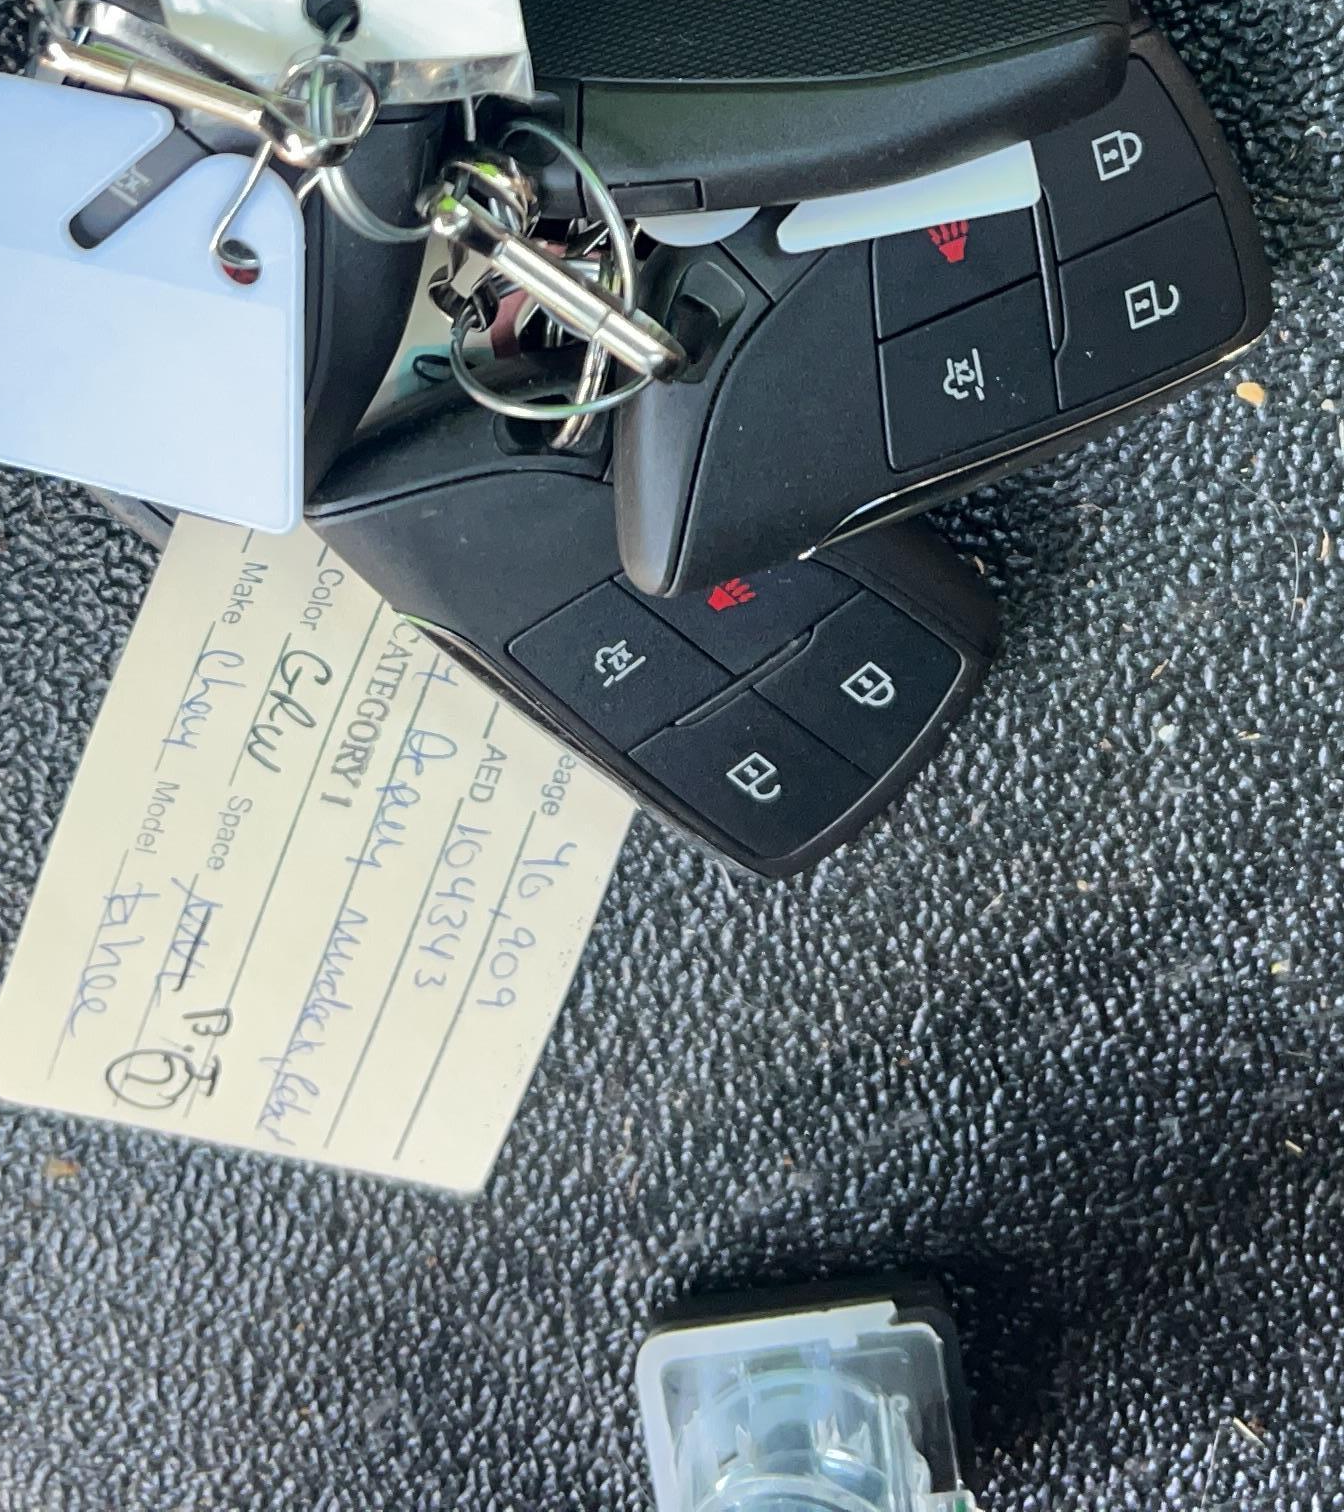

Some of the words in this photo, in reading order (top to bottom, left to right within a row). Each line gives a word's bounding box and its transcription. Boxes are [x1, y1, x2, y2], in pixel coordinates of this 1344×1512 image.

[221, 560, 271, 626] Make
[299, 567, 346, 632] Color
[330, 620, 421, 790] CATEGORY
[468, 742, 510, 804] AED
[540, 750, 578, 818] eage
[135, 779, 182, 856] Model
[206, 793, 255, 873] Space
